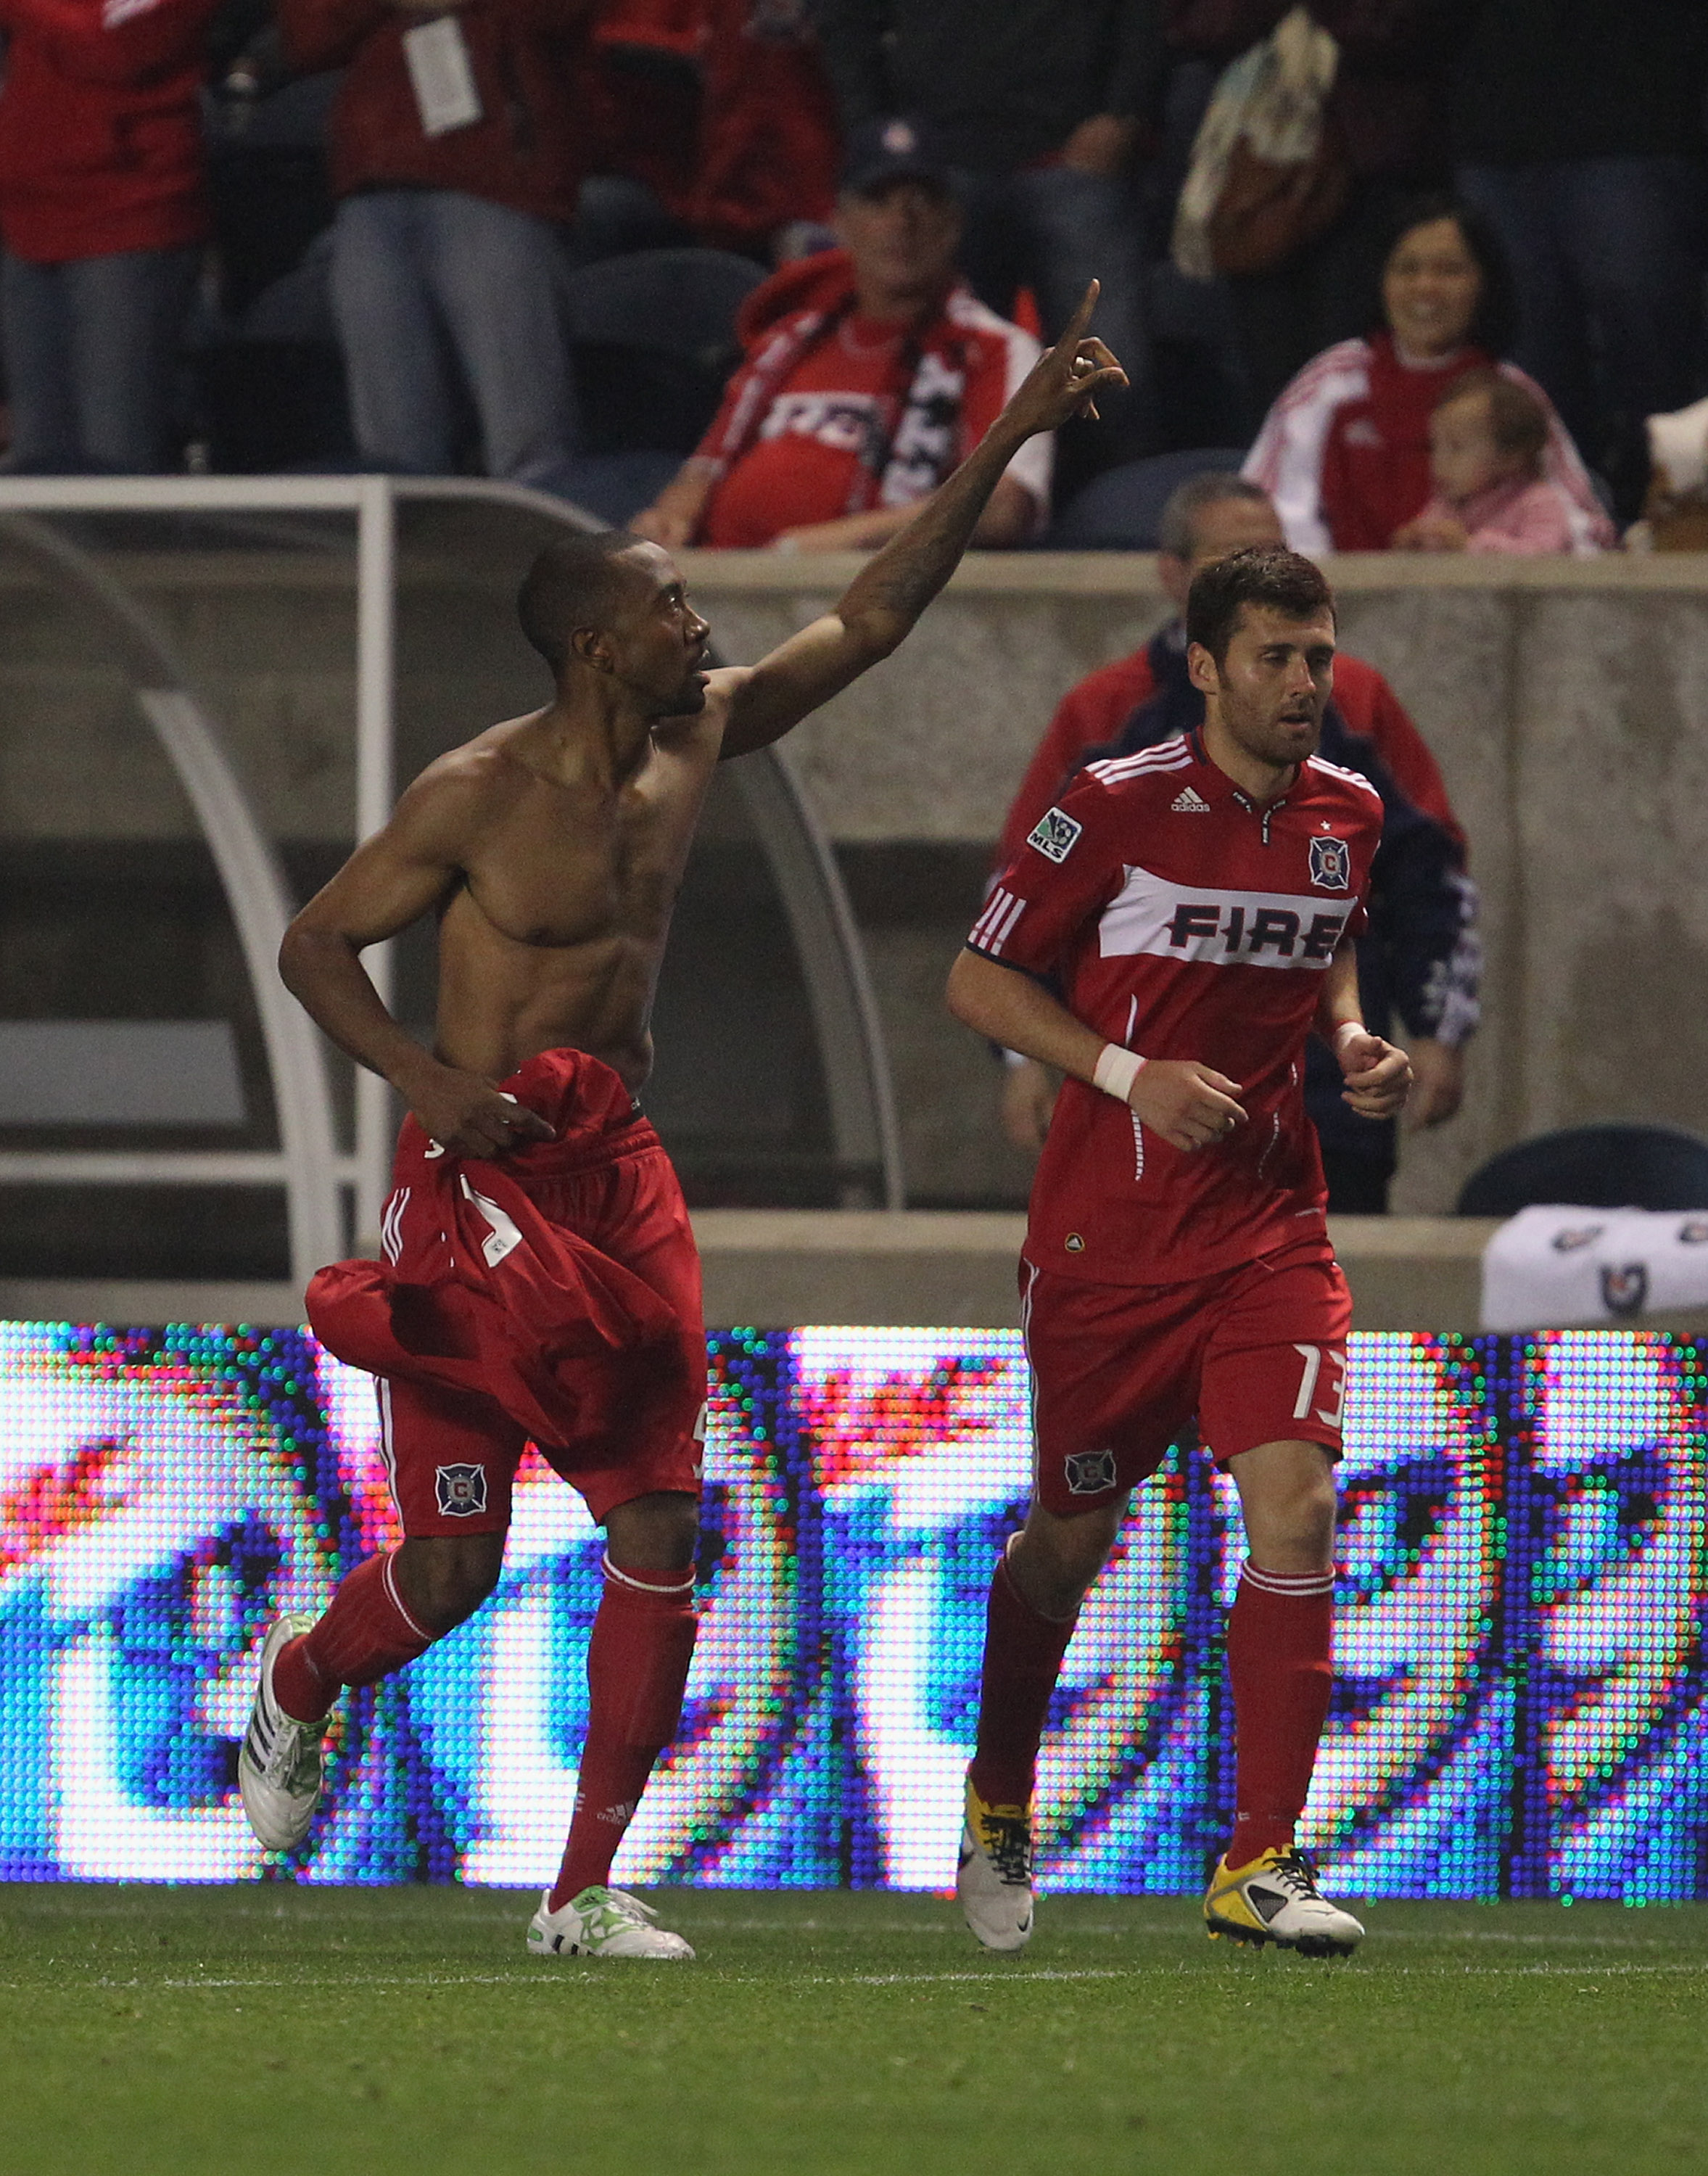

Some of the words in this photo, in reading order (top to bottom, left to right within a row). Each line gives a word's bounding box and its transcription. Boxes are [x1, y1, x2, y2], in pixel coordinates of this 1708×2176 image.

[1171, 804, 1210, 812] adidas
[1030, 833, 1064, 858] MLS
[1324, 854, 1337, 872] C
[1163, 904, 1345, 959] FIRE
[1292, 1343, 1347, 1429] 13
[454, 1482, 469, 1498] C
